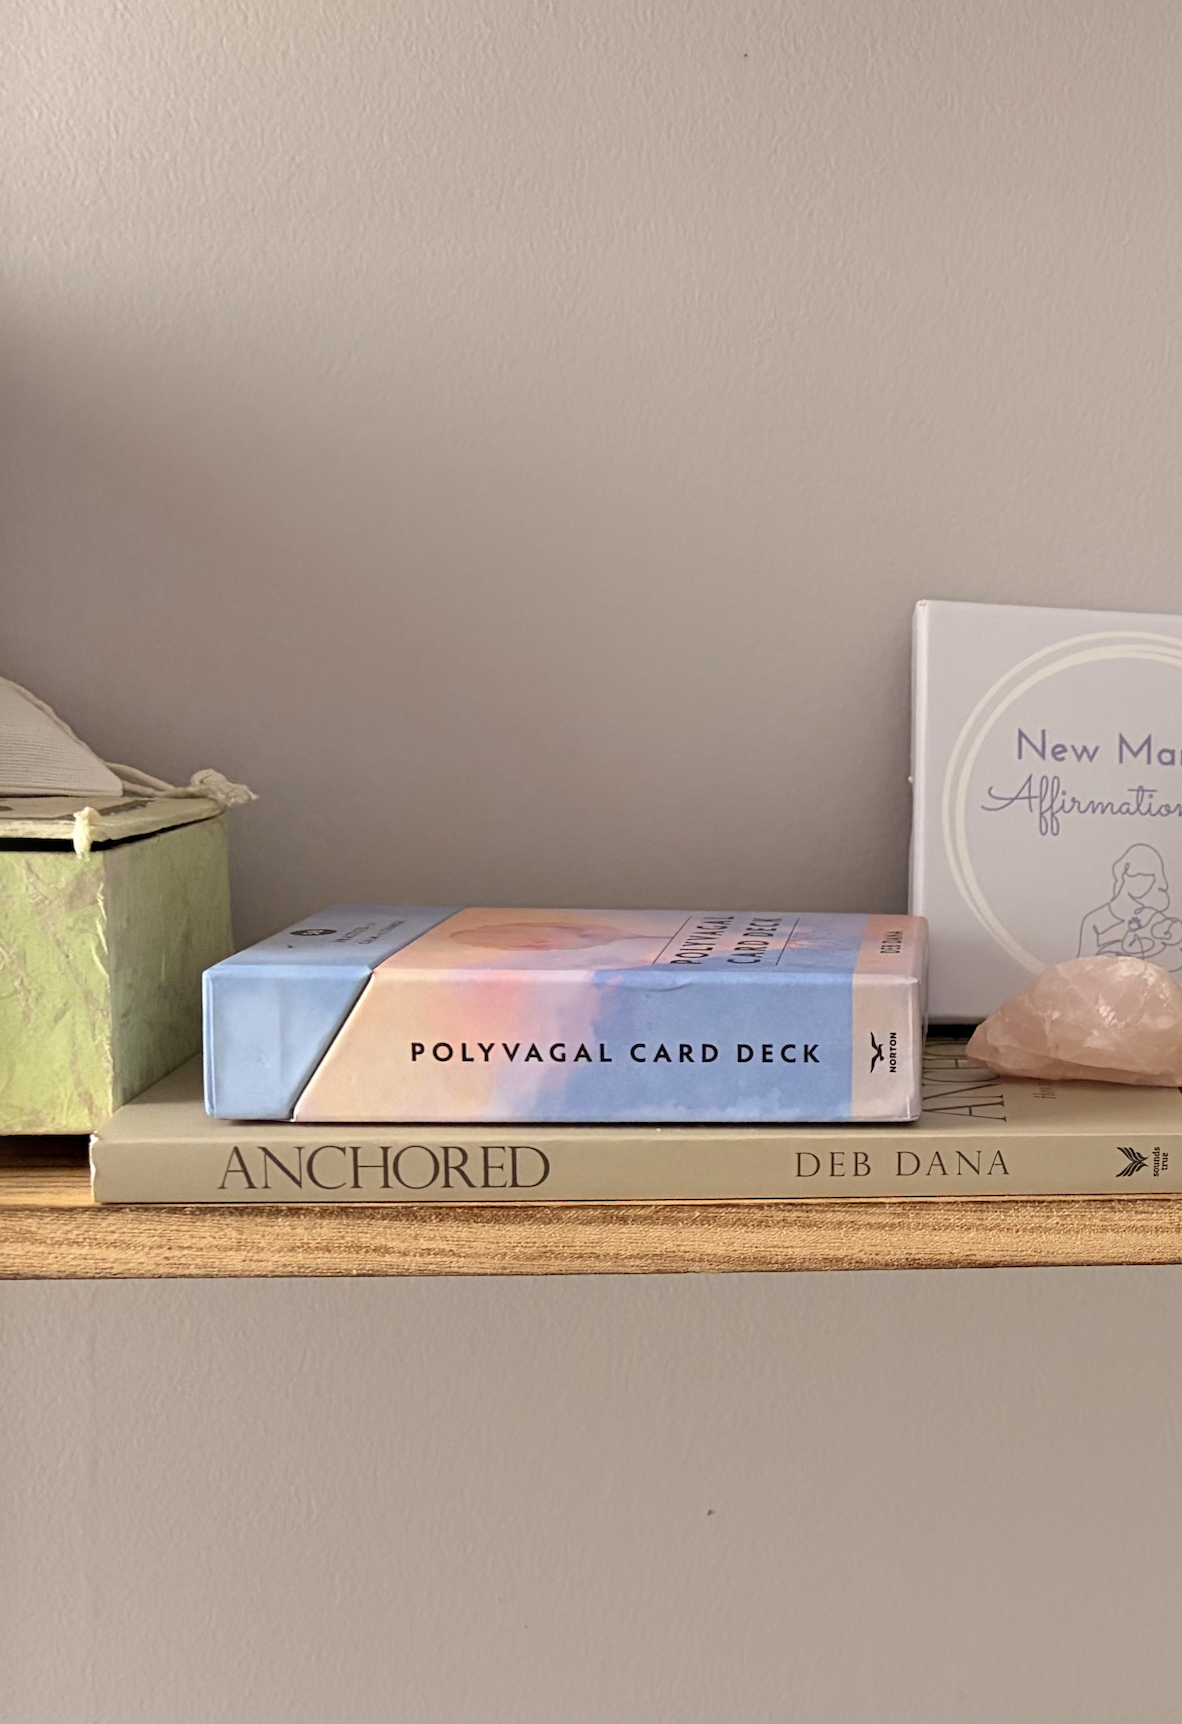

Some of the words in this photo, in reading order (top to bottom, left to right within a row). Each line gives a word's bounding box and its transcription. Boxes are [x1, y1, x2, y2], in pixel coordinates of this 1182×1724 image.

[1017, 727, 1100, 763] New
[670, 916, 735, 965] POLYVAGAL
[743, 917, 783, 938] DECK
[727, 940, 769, 964] CARD
[411, 1042, 612, 1062] POLYVAGAL
[630, 1043, 719, 1063] CARD
[737, 1043, 820, 1063] DECK
[889, 1032, 897, 1073] NORTON
[218, 1144, 550, 1190] ANCHORED
[795, 1151, 871, 1178] DEB
[895, 1149, 1010, 1177] DANA
[1152, 1146, 1160, 1177] sounds
[1161, 1152, 1169, 1171] true
